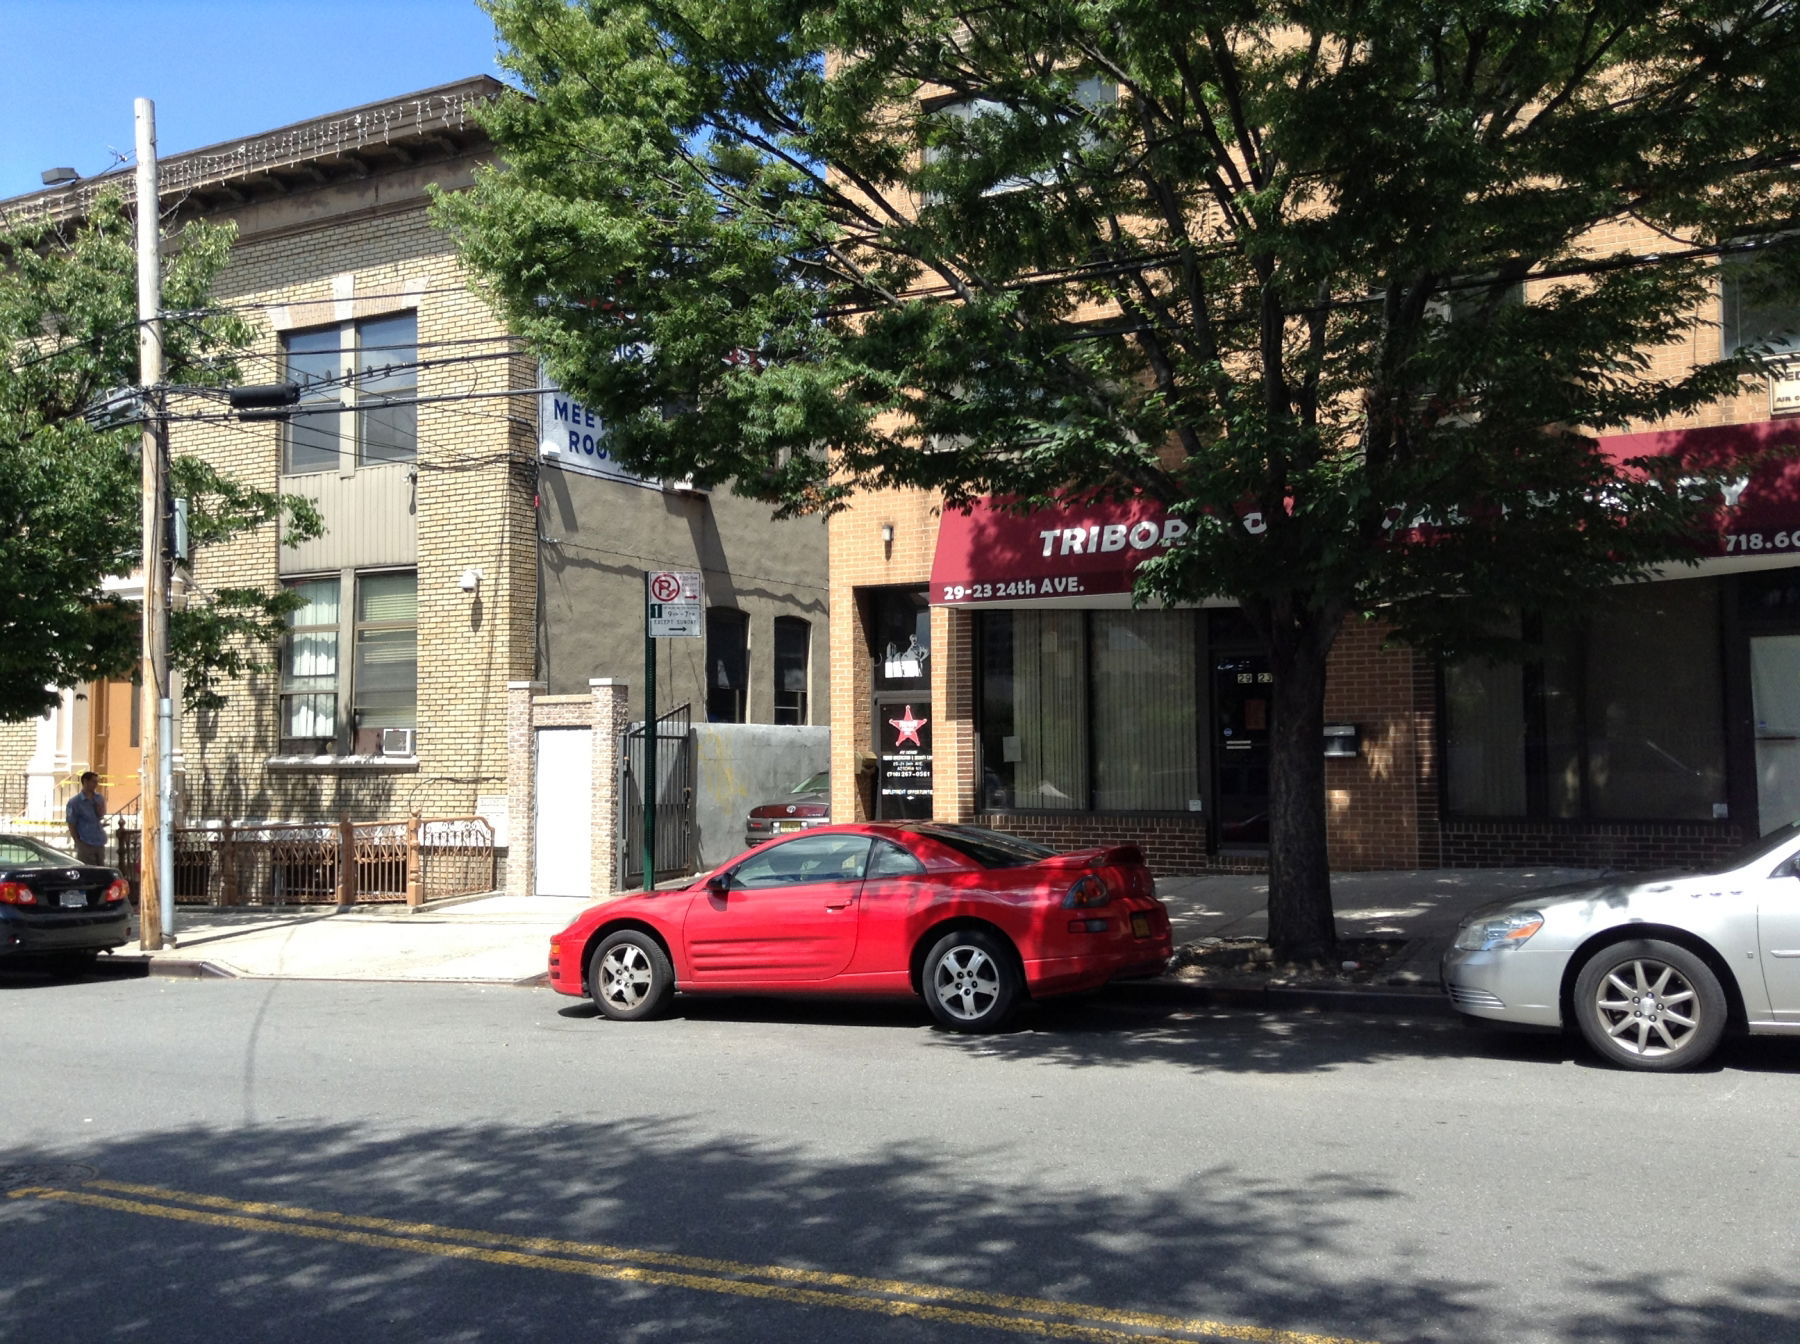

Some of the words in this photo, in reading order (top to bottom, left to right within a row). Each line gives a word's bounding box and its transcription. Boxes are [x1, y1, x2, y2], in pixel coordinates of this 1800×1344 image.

[569, 430, 607, 459] ROO
[1039, 518, 1189, 557] TRIBOR
[943, 584, 992, 600] 29-23
[996, 579, 1036, 597] 24th
[1040, 576, 1085, 594] AVE.
[1238, 673, 1252, 683] 29
